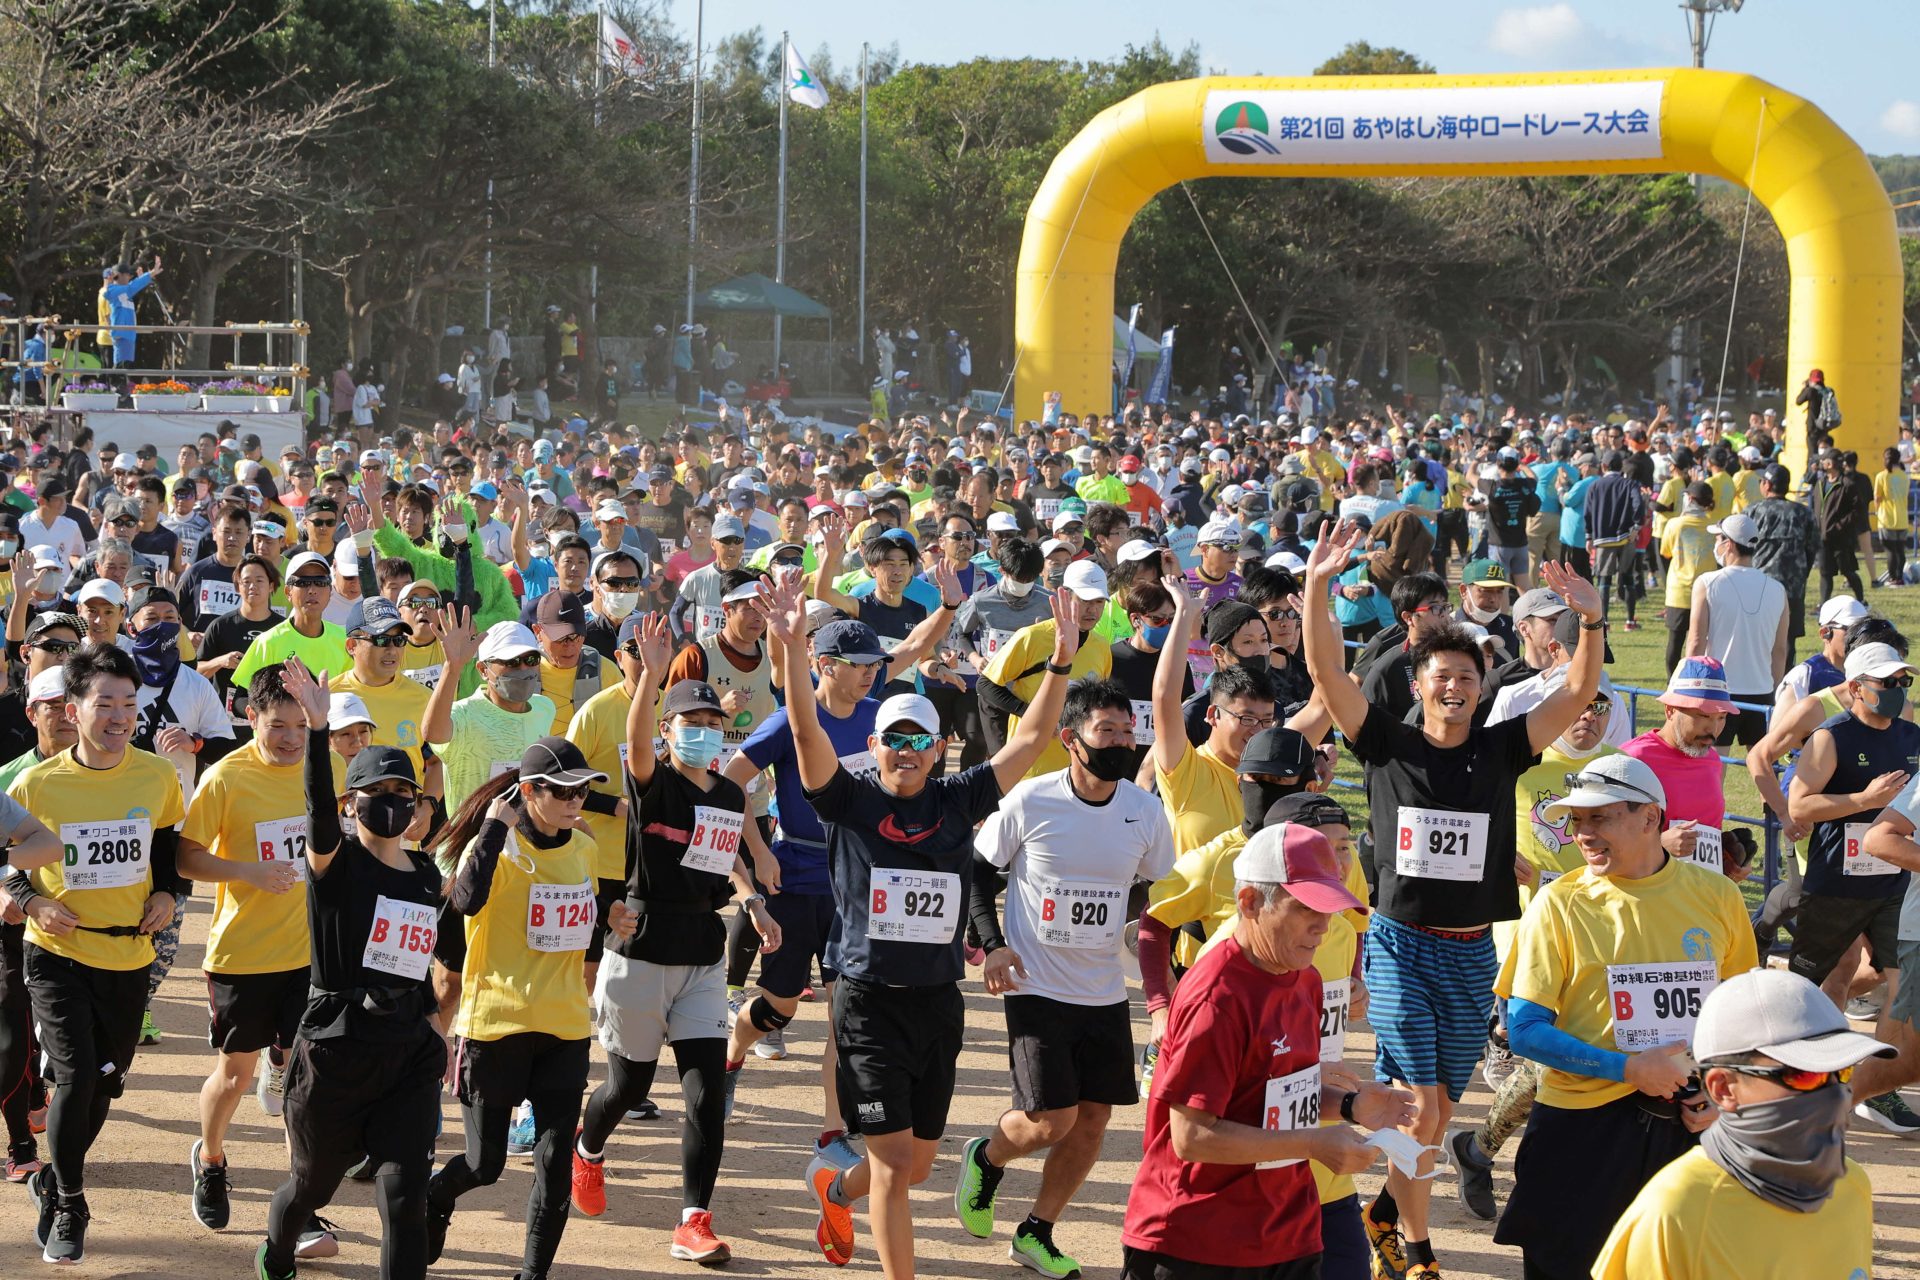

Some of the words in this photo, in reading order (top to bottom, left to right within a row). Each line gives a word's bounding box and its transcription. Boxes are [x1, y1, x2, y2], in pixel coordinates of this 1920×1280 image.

[1280, 116, 1344, 140] 第21回
[1352, 109, 1649, 140] あやはし海中ロードレース大会
[202, 590, 209, 602] B
[214, 590, 241, 605] 1147
[703, 614, 710, 626] B
[989, 639, 997, 652] B
[693, 824, 706, 846] B
[1400, 827, 1413, 851] B
[1429, 830, 1469, 856] 921
[1847, 838, 1859, 858] B
[64, 843, 78, 867] D
[88, 839, 142, 865] 2808
[261, 841, 275, 861] B
[531, 904, 546, 928] B
[556, 899, 593, 928] 1241
[872, 889, 887, 914] B
[904, 891, 945, 918] 922
[1042, 898, 1056, 922] B
[1071, 902, 1108, 926] 920
[372, 917, 390, 943] B
[1614, 991, 1634, 1020] B
[1653, 987, 1702, 1019] 905
[857, 1101, 884, 1114] NIKE
